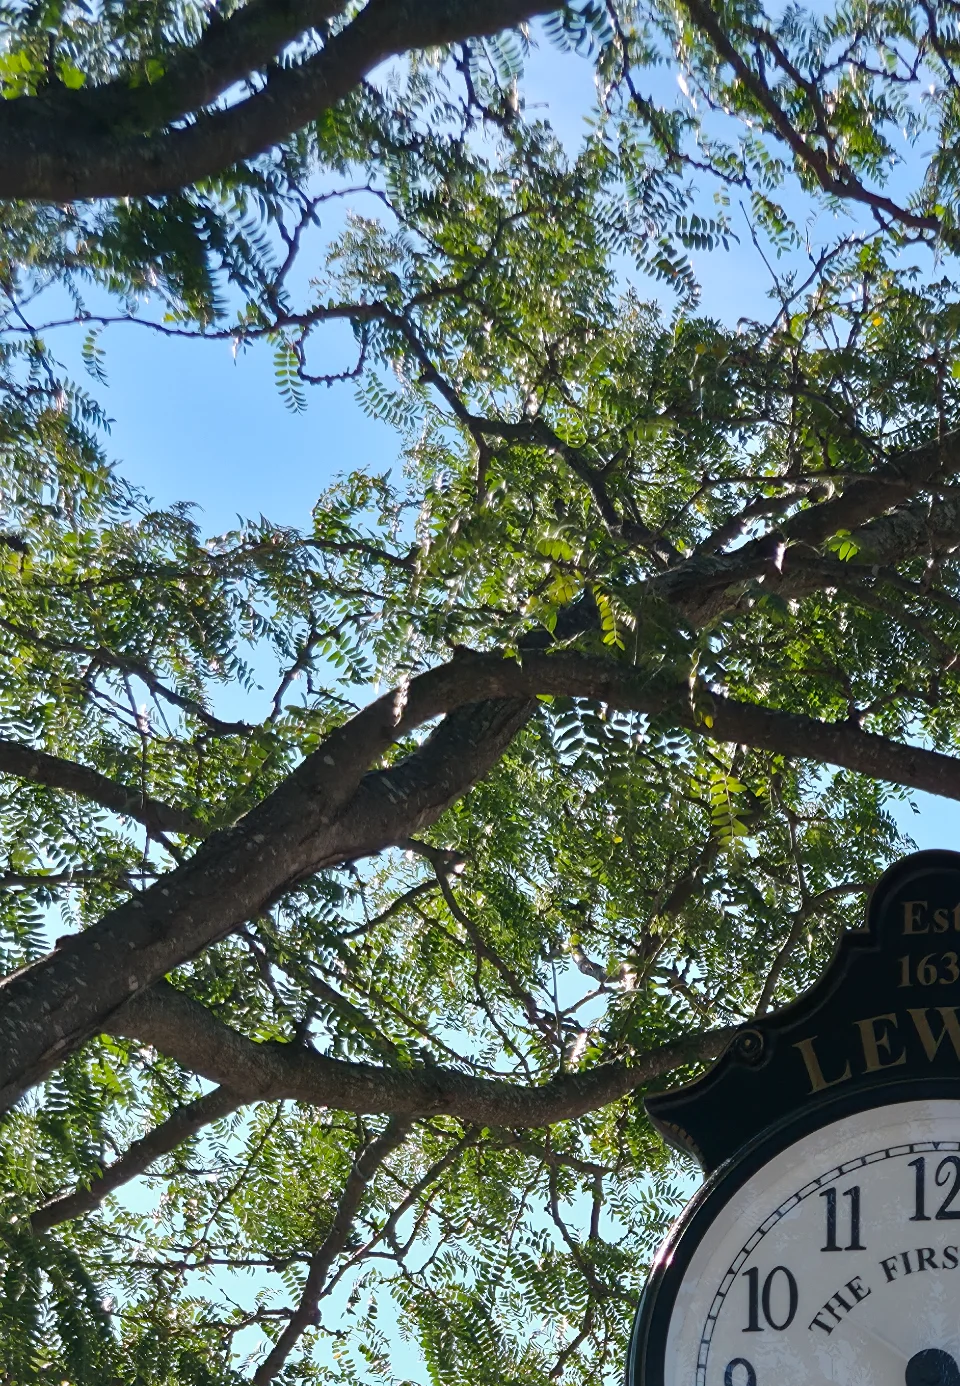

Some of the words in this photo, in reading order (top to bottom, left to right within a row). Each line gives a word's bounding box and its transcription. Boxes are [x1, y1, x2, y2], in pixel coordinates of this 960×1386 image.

[818, 1184, 867, 1252] 11
[741, 1265, 799, 1333] 10
[807, 1275, 872, 1336] THE
